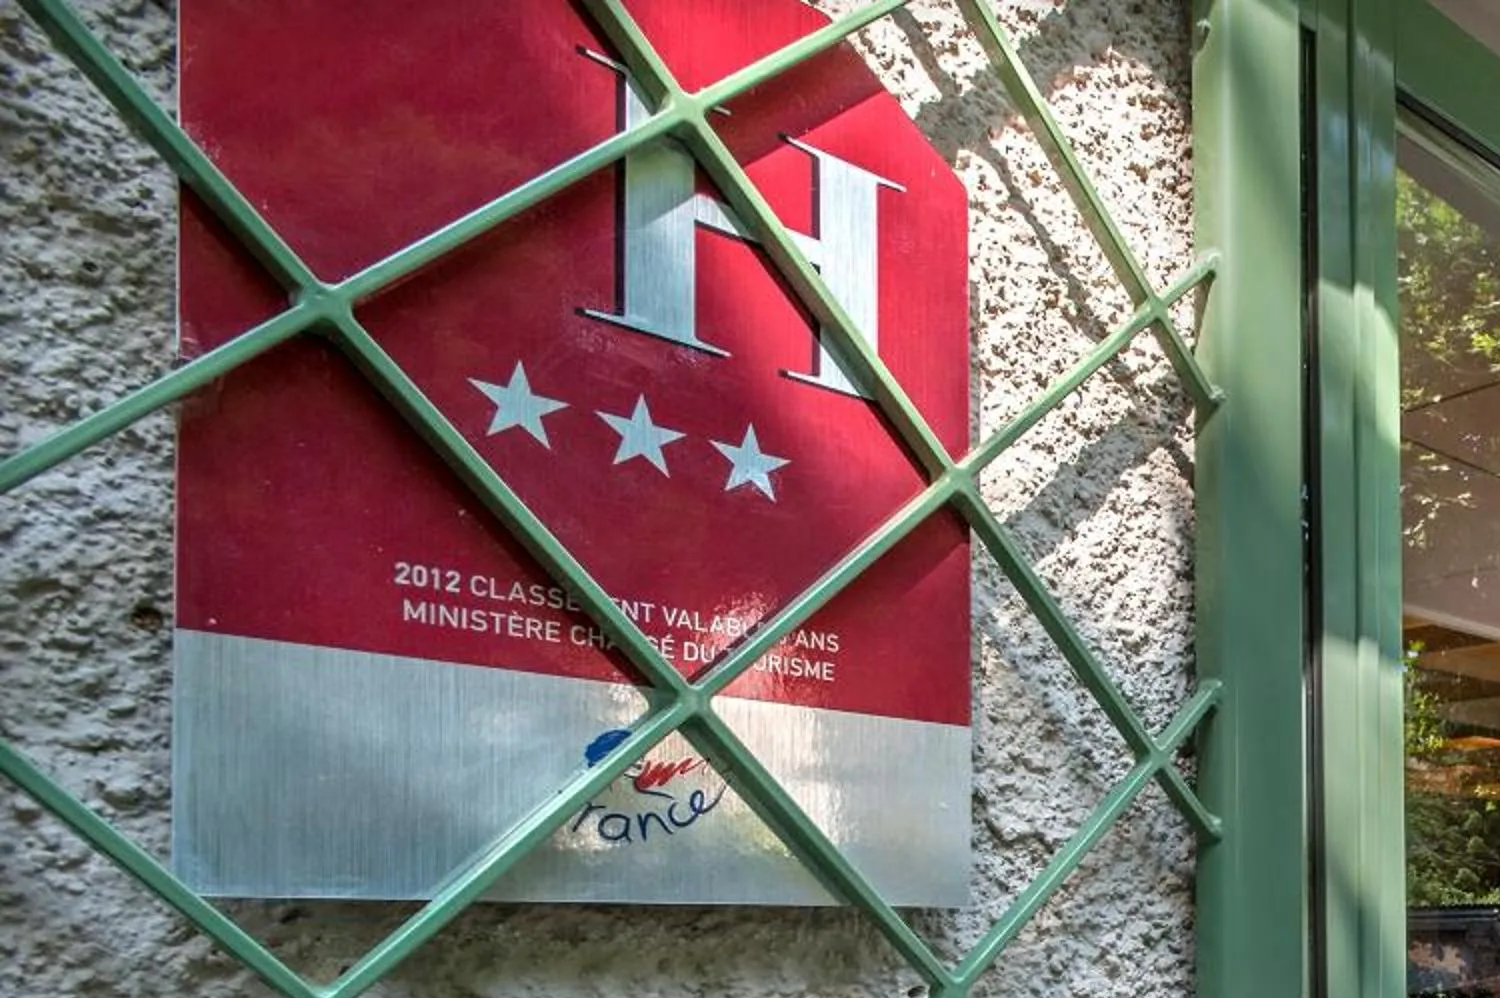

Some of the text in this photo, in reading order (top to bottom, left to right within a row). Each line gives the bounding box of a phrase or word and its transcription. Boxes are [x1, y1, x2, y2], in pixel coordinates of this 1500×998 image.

[575, 46, 907, 402] H
[394, 561, 461, 594] 2012
[795, 630, 840, 653] ANS
[403, 598, 561, 644] MINISTÈRE
[683, 642, 716, 663] DU
[558, 785, 727, 843] rance
